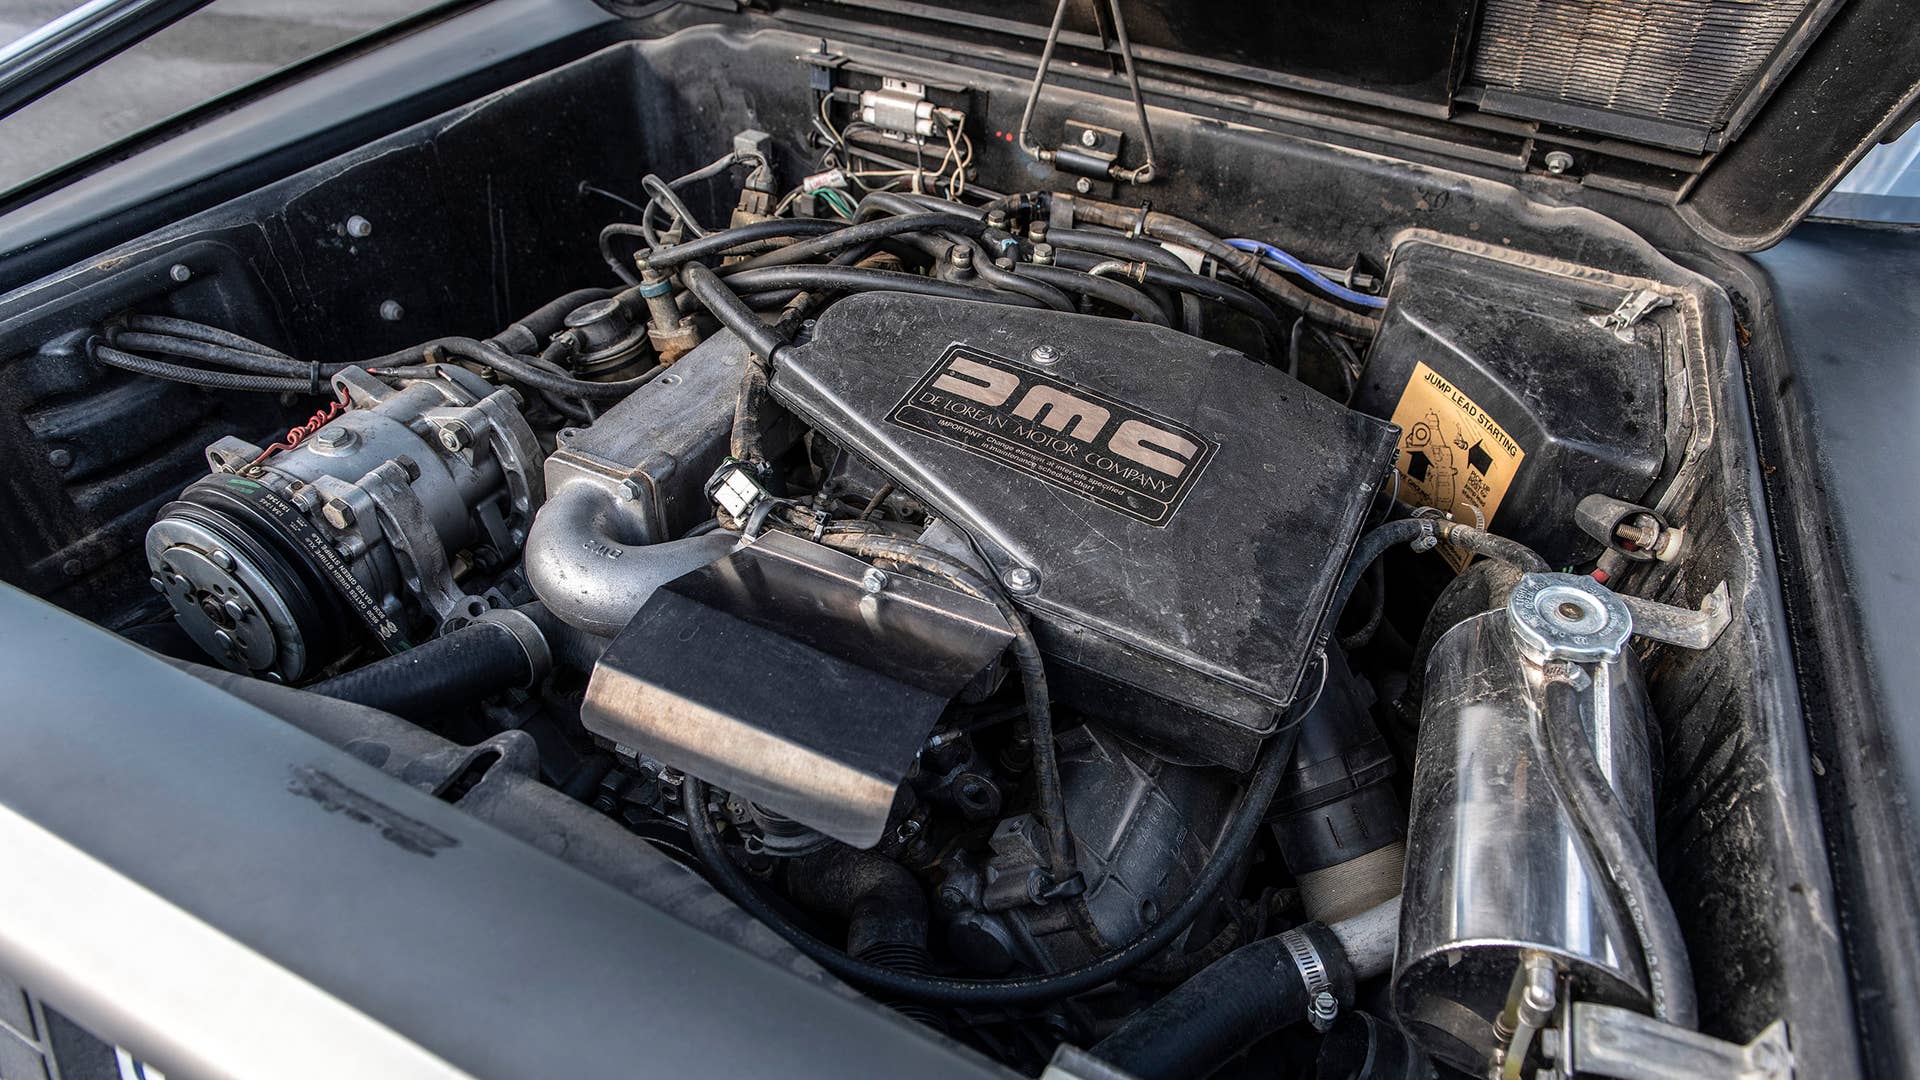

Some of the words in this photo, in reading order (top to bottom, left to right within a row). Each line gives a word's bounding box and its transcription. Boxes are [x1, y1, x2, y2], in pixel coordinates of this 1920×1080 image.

[932, 356, 1198, 478] DMC
[1424, 372, 1452, 394] JUMP
[1451, 391, 1477, 417] LEAD
[1477, 413, 1518, 457] STARTING
[919, 391, 944, 405] DE
[943, 400, 1008, 429] LOREAN
[1013, 424, 1079, 458] MOTOR
[1085, 452, 1173, 494] COMPANY
[985, 436, 1015, 451] Change
[1015, 448, 1045, 464] element
[1055, 462, 1087, 481] intervals
[1088, 477, 1125, 496] specified
[988, 444, 1037, 469] maintenance
[1037, 464, 1073, 482] schedule
[1073, 479, 1095, 492] chart
[314, 549, 335, 571] STRIPE
[320, 544, 341, 566] STRIPE
[331, 569, 351, 590] GREEN
[338, 565, 357, 586] GREEN
[348, 588, 367, 610] GATES
[355, 584, 374, 605] GATES
